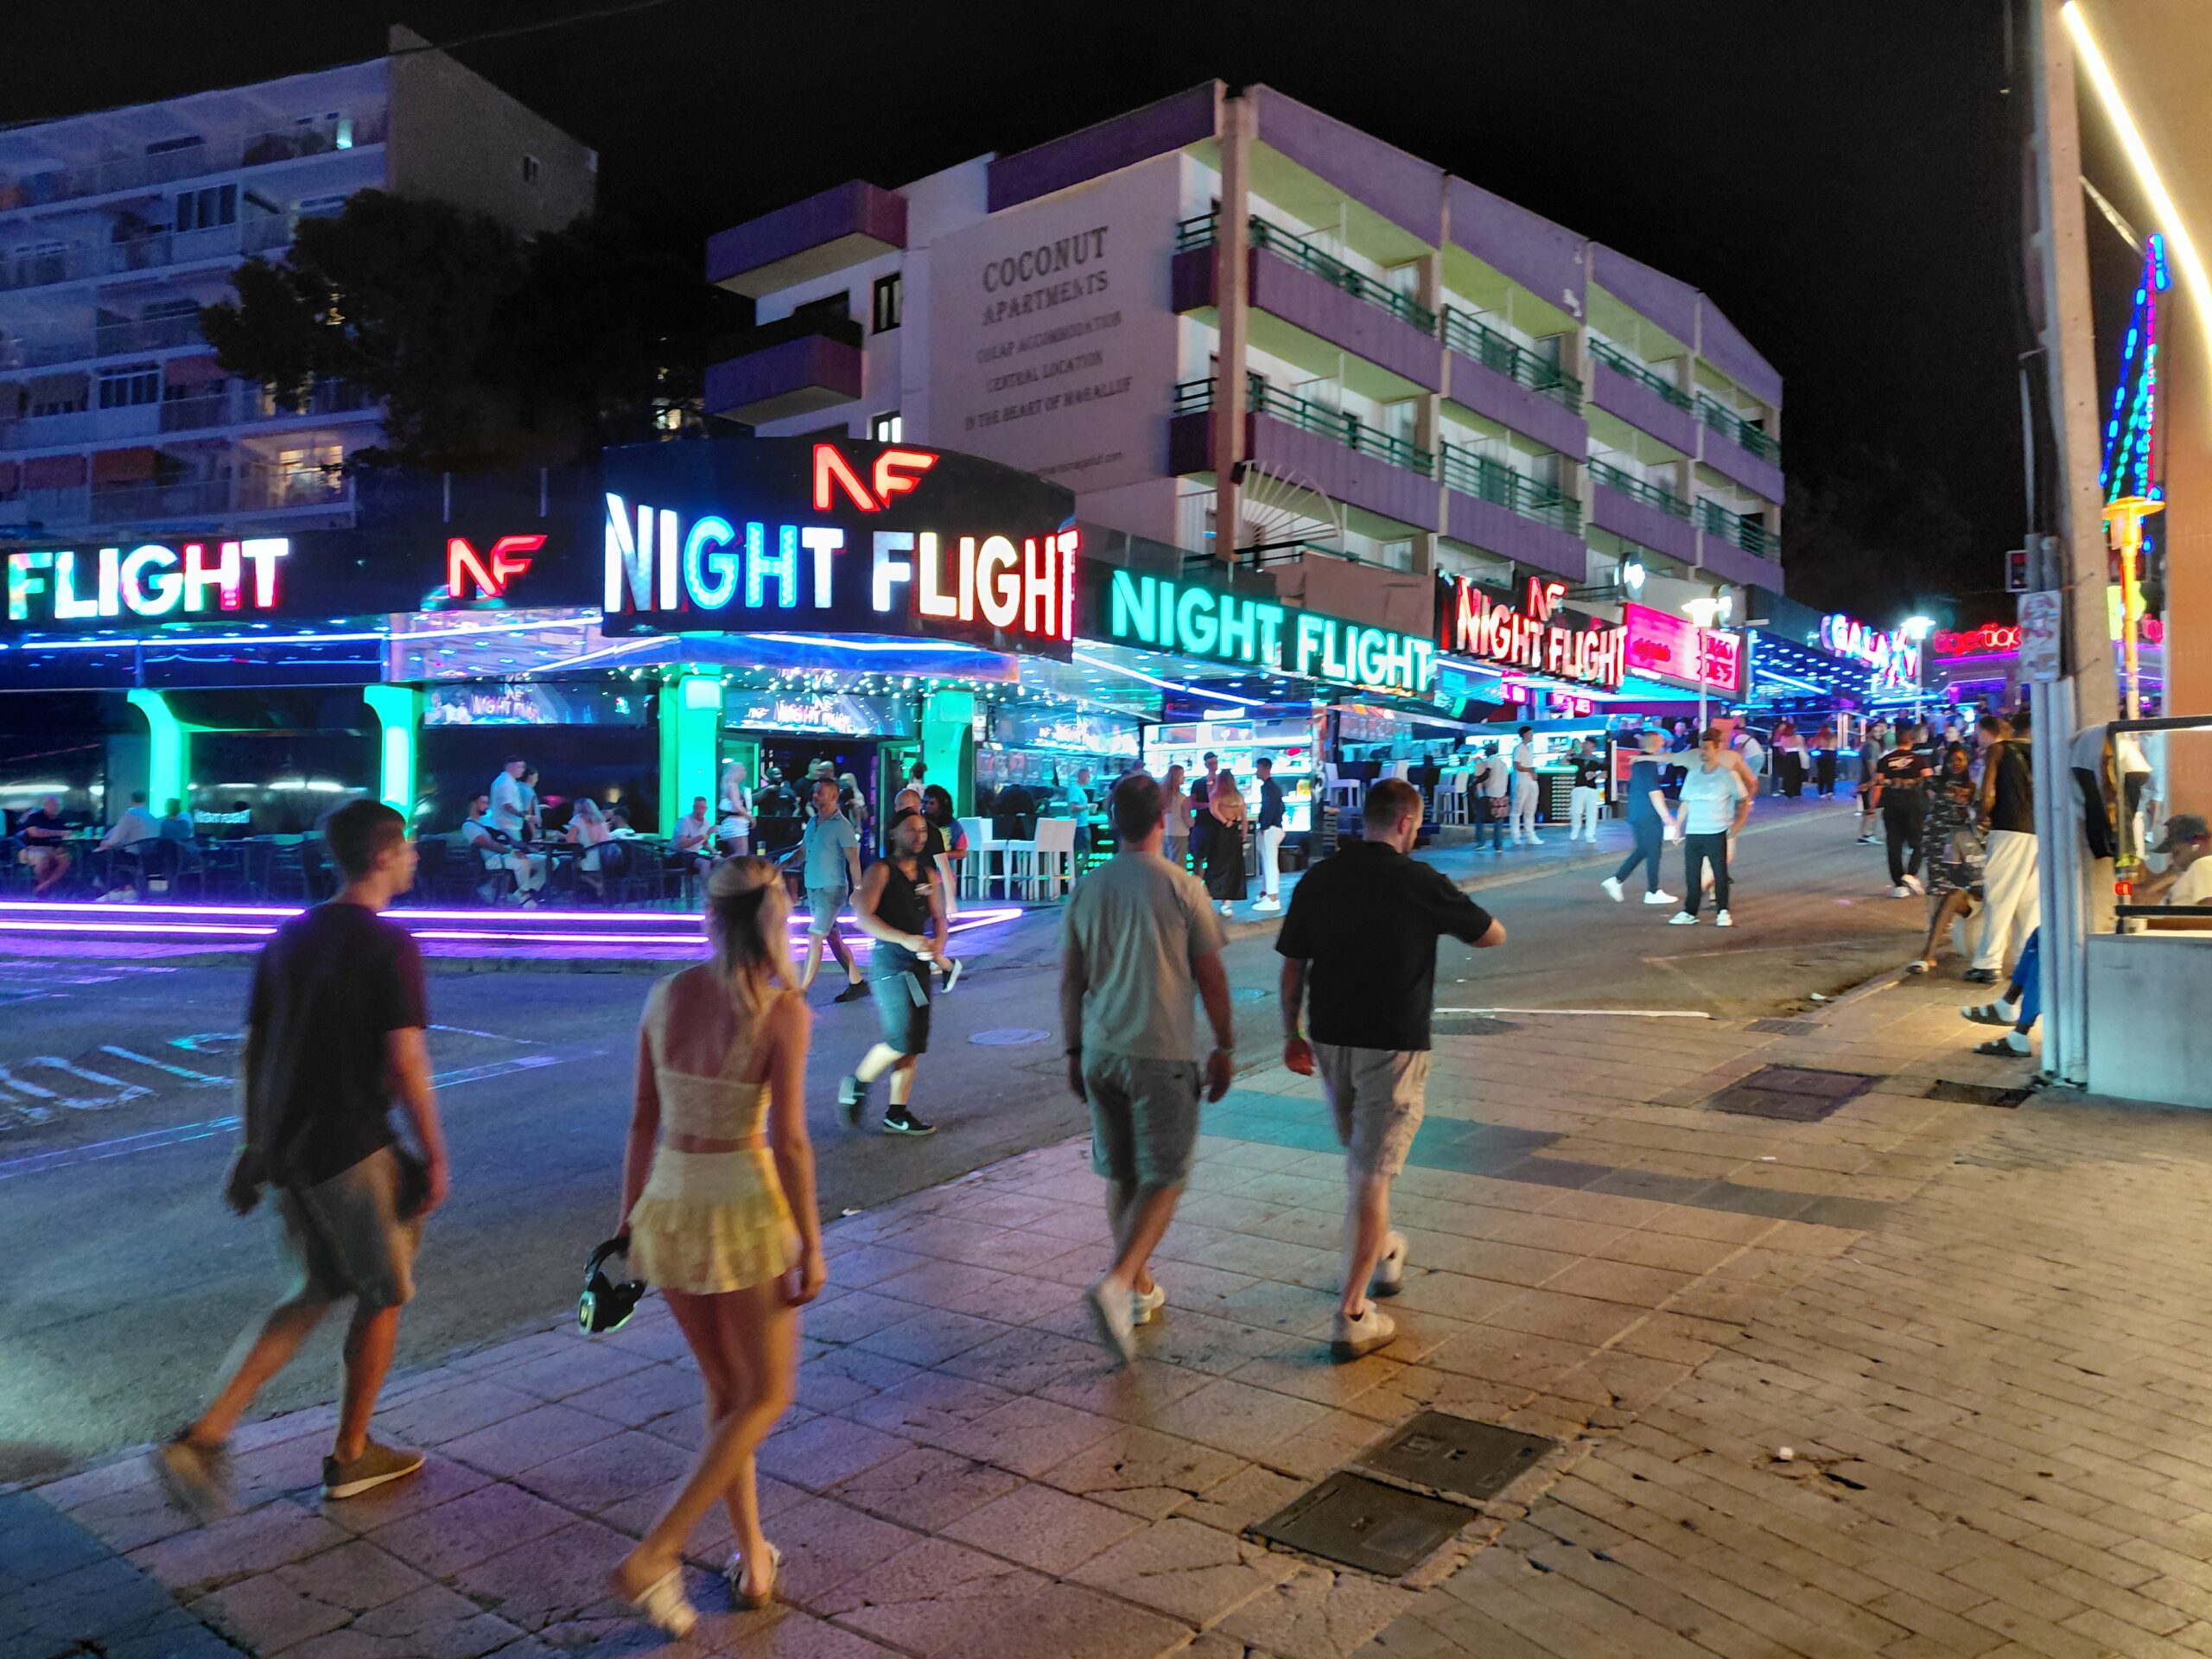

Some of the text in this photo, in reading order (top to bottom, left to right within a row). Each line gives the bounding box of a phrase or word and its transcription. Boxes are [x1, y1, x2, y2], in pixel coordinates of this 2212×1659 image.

[982, 226, 1109, 293] COCONUT
[982, 270, 1109, 326] APARTMENTS
[813, 443, 939, 512] NF
[9, 537, 289, 620] FLIGHT
[447, 534, 548, 598] NF
[604, 492, 1081, 642] NIGHT FLIGHT
[1112, 570, 1435, 692] NIGHT FLIGHT
[1457, 575, 1544, 668] NIGHT
[1549, 626, 1628, 687] FLIGHT
